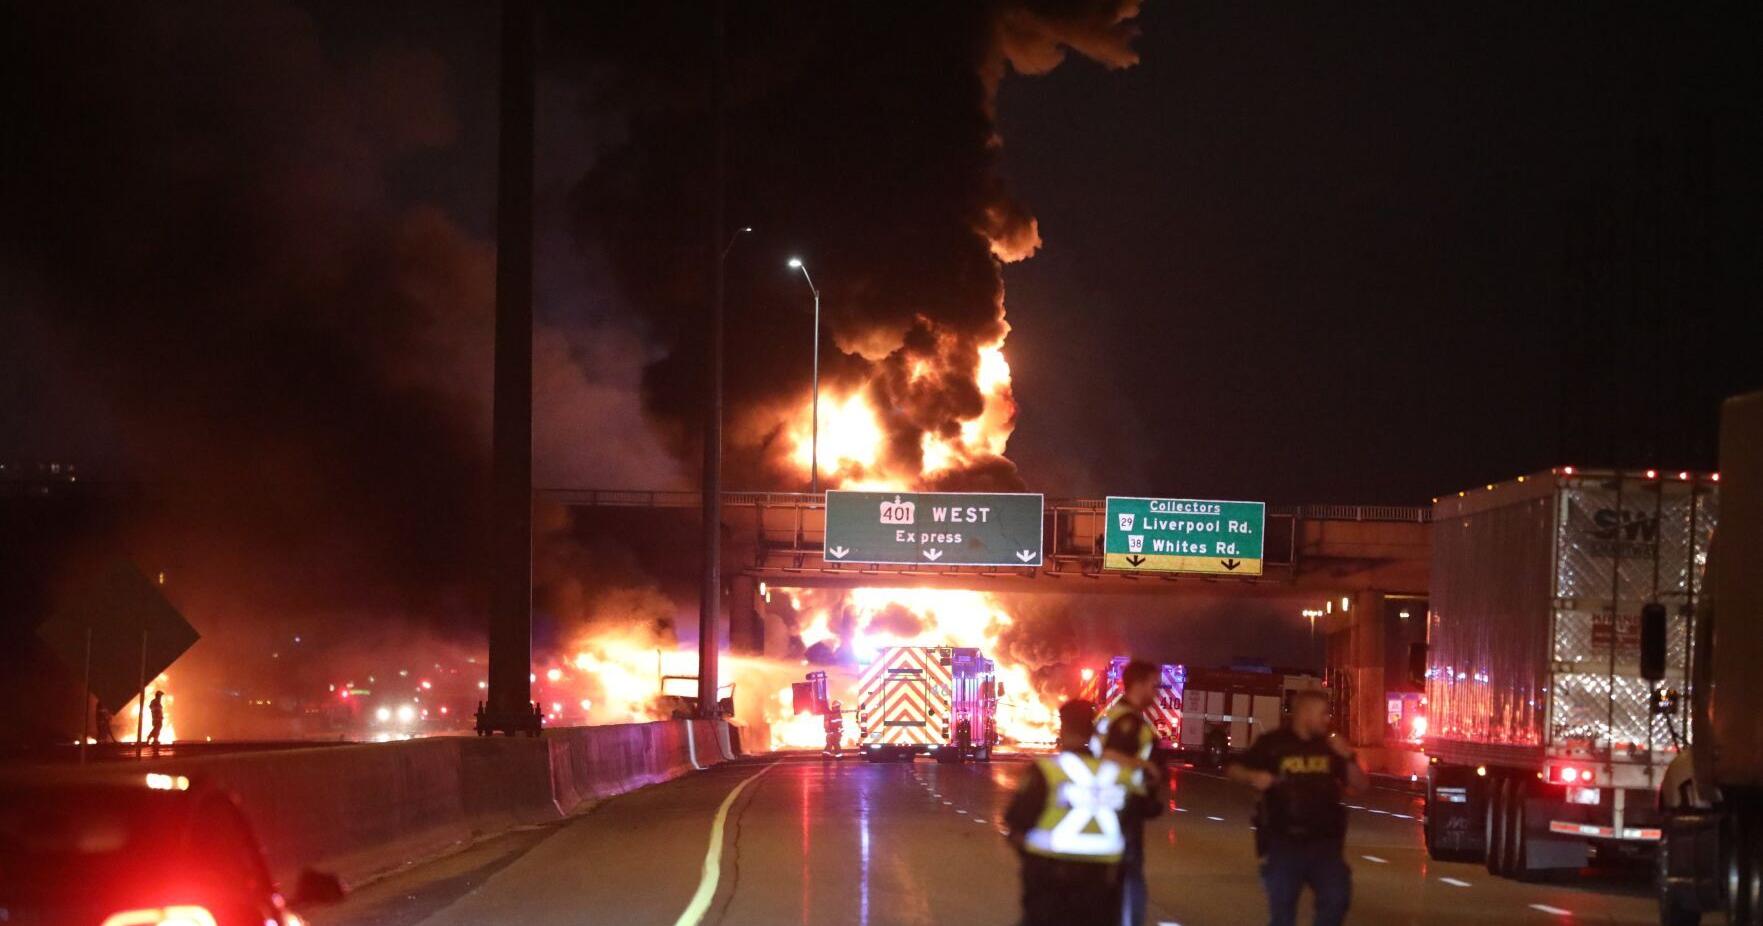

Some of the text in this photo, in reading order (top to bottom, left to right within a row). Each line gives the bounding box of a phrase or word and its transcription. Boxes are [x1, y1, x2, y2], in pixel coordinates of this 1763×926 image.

[1150, 500, 1221, 513] Collectors
[882, 507, 990, 523] 401 WEST
[1121, 517, 1252, 534] 29 Liverpool Rd.
[895, 529, 962, 544] Express
[1130, 538, 1240, 555] 38 Whites Rd.
[1160, 696, 1181, 710] 410
[1281, 755, 1330, 774] POLICE
